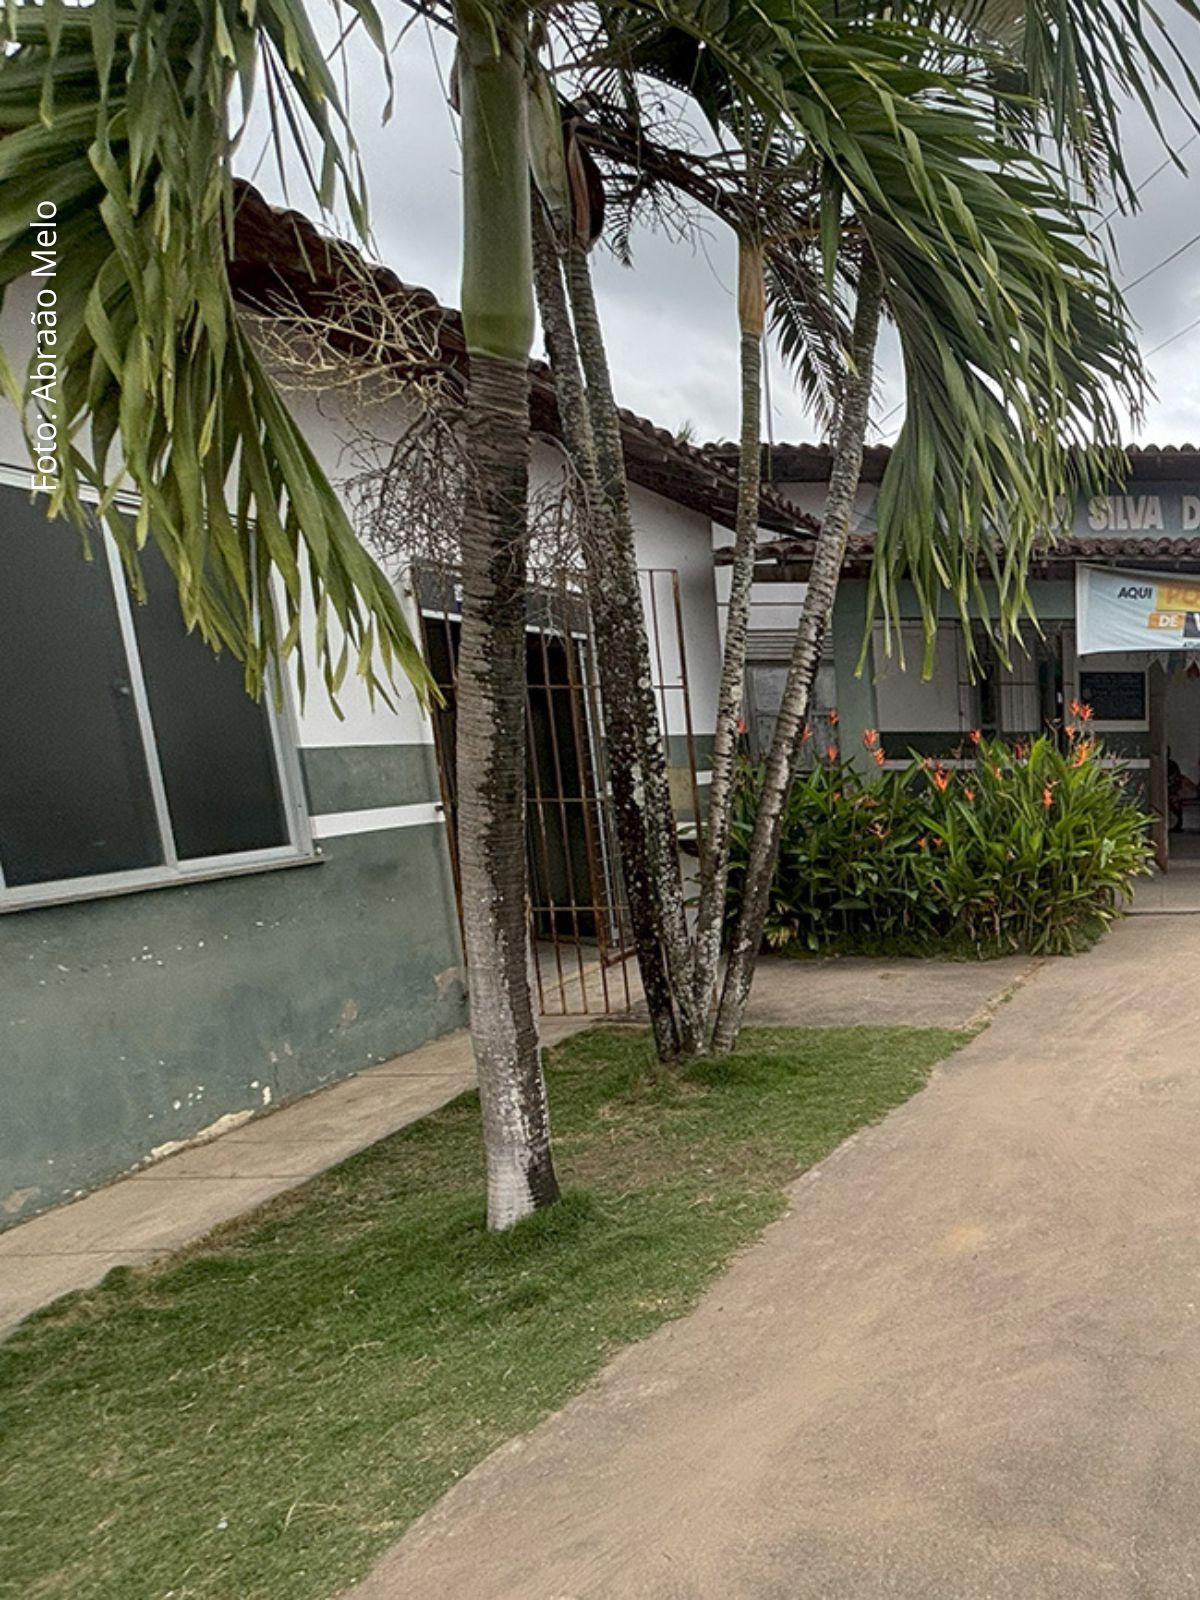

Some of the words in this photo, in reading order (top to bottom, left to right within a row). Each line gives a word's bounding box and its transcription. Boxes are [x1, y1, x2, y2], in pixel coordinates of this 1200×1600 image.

[1088, 495, 1164, 530] SILVA
[1117, 586, 1153, 600] AQUI
[1158, 612, 1179, 628] DE
